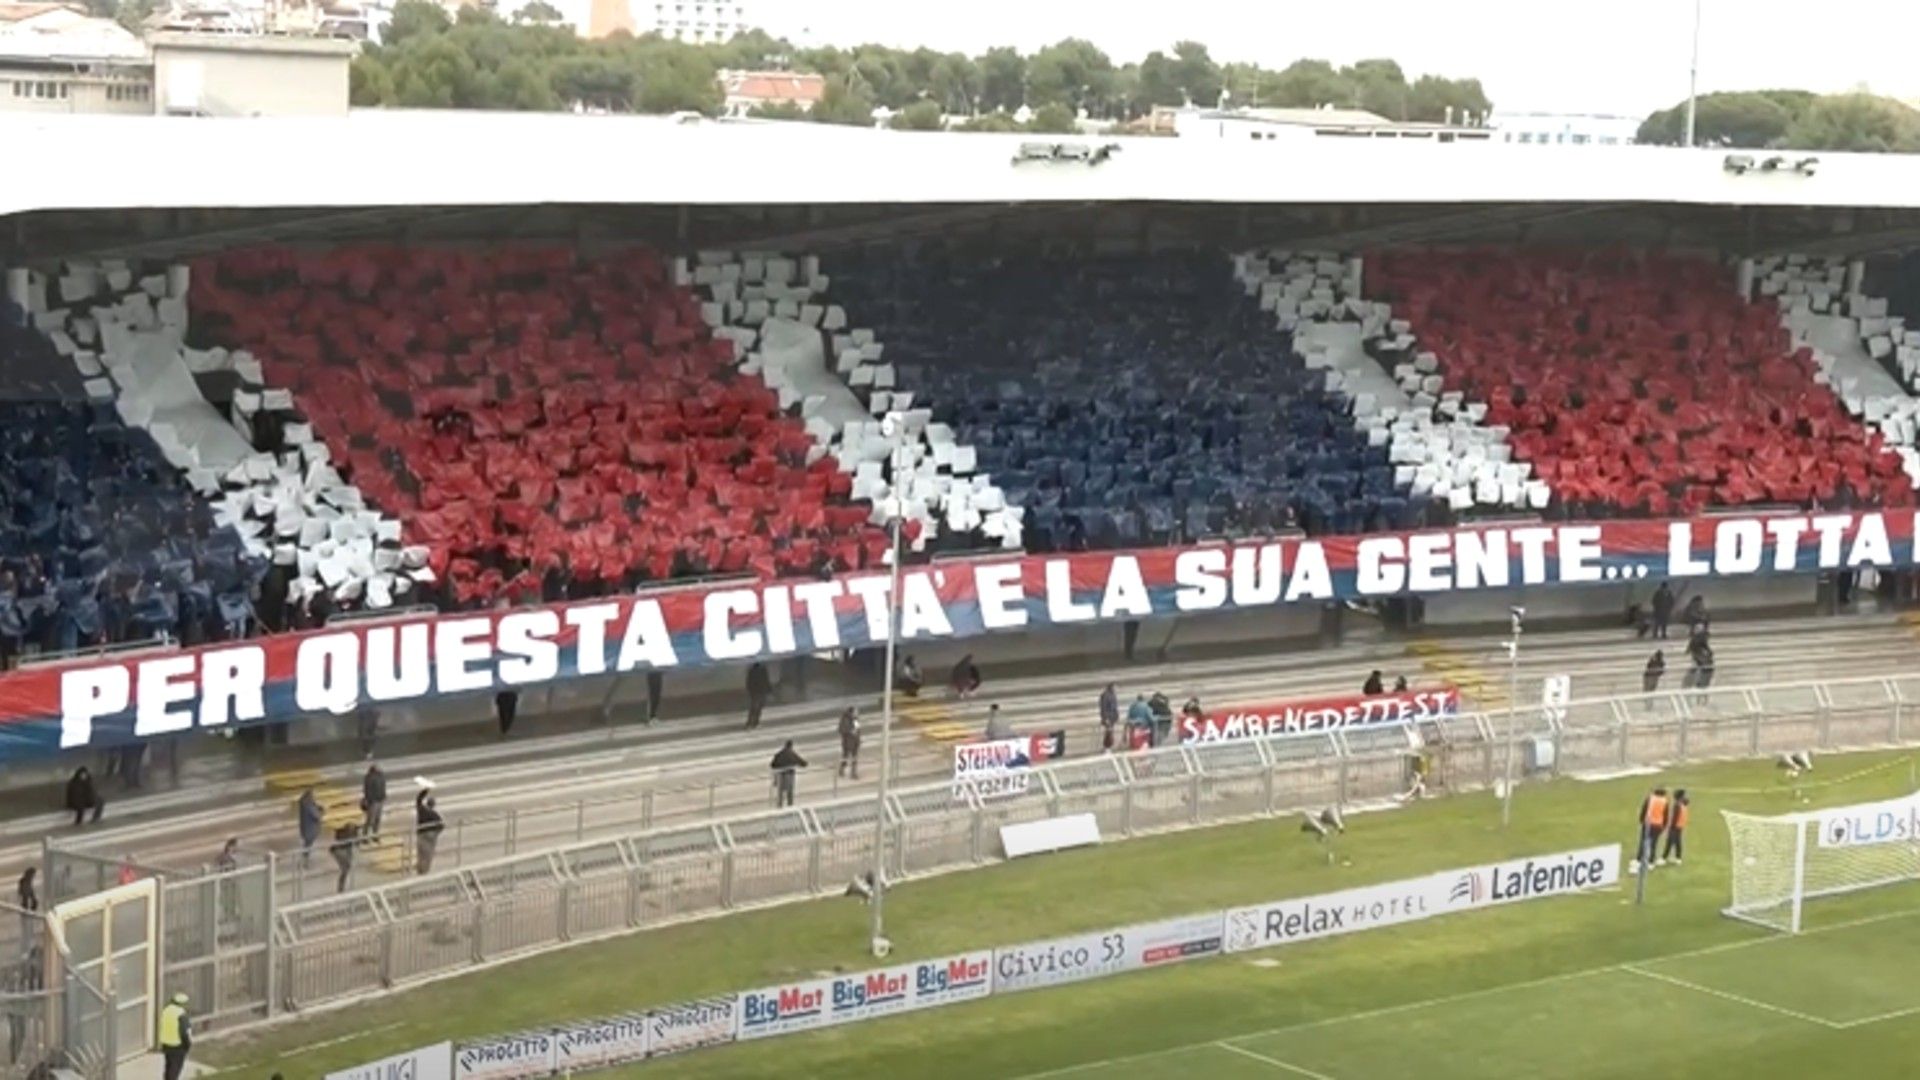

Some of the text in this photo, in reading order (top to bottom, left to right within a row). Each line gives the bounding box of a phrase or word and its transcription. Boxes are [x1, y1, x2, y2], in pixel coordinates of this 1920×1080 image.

[60, 646, 266, 748] PER
[295, 600, 679, 715] QUESTA
[974, 563, 1029, 629] E
[1045, 556, 1152, 623] LA
[1175, 541, 1333, 611] SUA
[1356, 525, 1648, 594] GENTE...
[1668, 511, 1893, 577] LOTTA
[1491, 854, 1604, 900] Lafenice
[1264, 895, 1427, 940] Relax HOTEL
[999, 945, 1090, 978] Civico
[1101, 933, 1126, 962] 53
[832, 973, 908, 1008] BigMat
[916, 958, 988, 992] BigMat
[668, 1002, 732, 1029] PROGETTO
[744, 986, 823, 1022] BigMat
[478, 1037, 550, 1063] PROGETTO
[576, 1020, 643, 1047] PROGETTO
